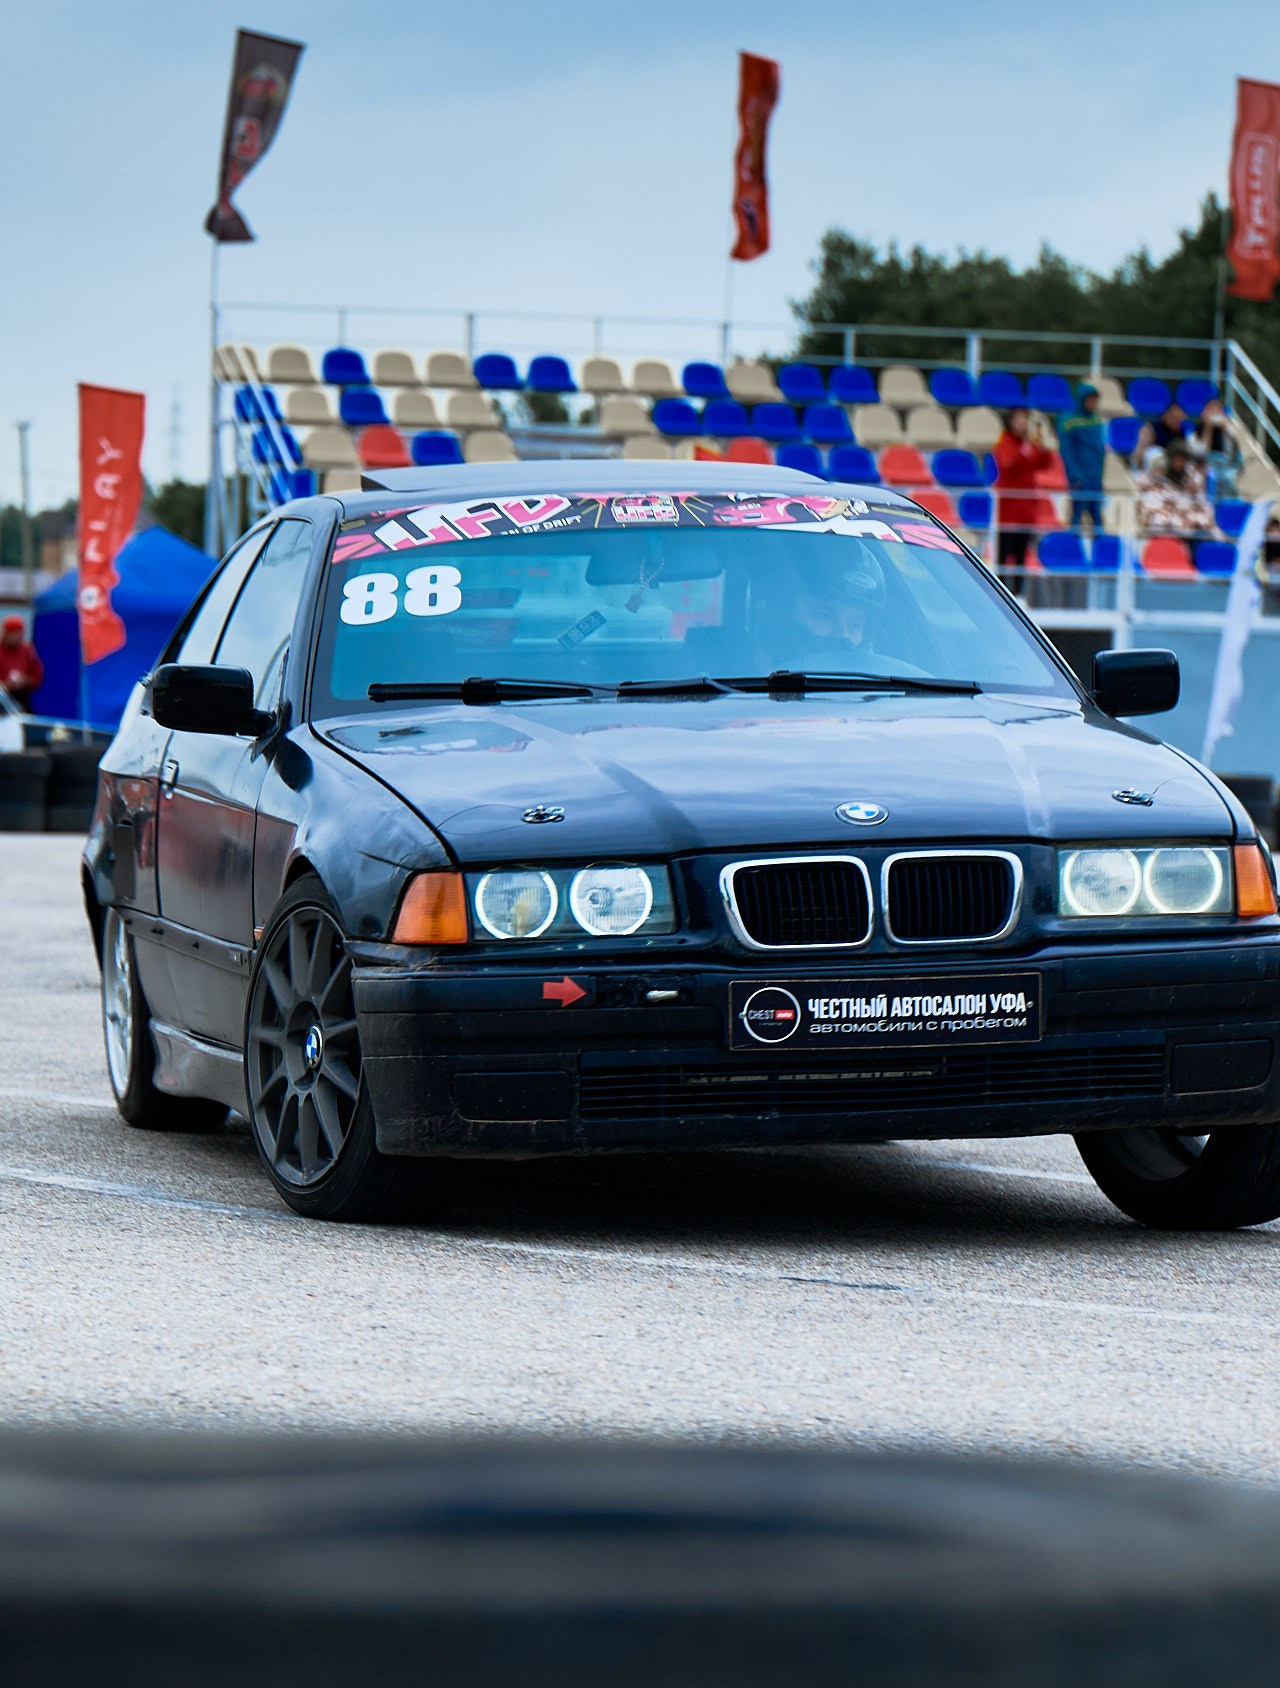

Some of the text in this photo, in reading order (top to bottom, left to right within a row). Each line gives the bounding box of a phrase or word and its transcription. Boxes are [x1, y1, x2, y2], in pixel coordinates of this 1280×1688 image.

[522, 523, 541, 534] OF
[542, 514, 582, 530] DRIFT
[340, 564, 463, 625] 88
[807, 992, 1027, 1019] ЧЕСТНЫЙ АВТОСАЛОН УФА
[809, 1016, 1027, 1033] автомобили с пробегом
